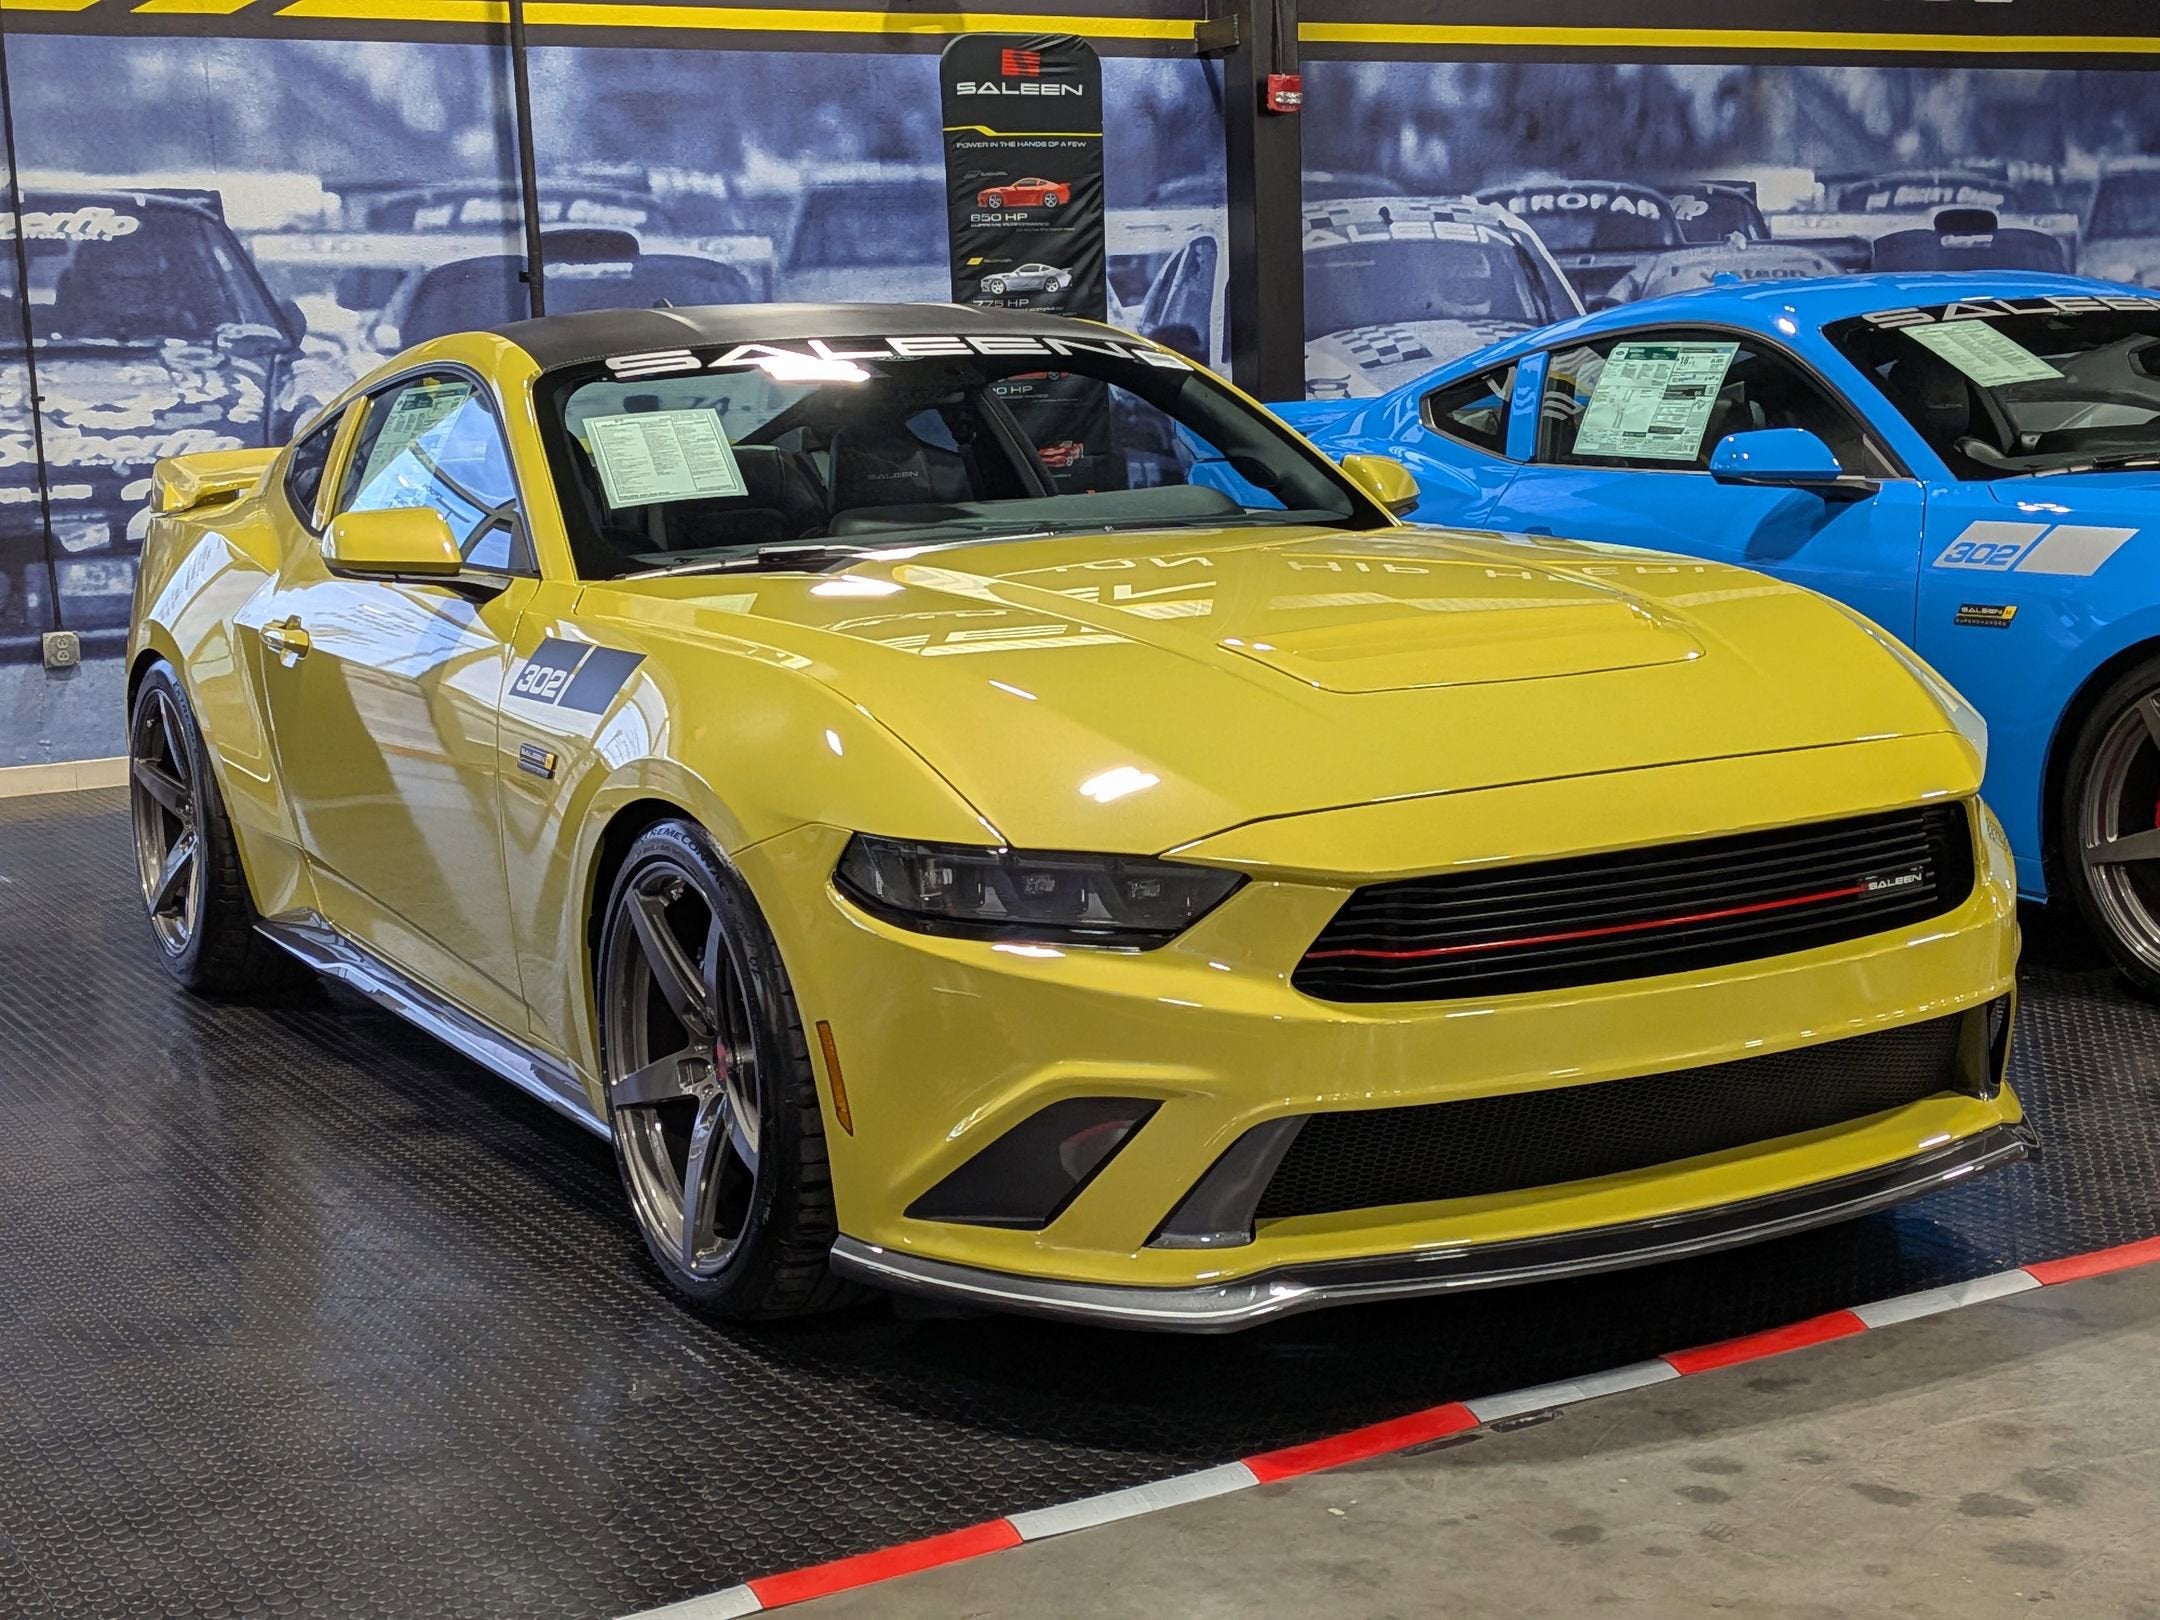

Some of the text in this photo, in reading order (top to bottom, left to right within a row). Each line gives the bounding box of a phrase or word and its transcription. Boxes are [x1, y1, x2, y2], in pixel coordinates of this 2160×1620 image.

[956, 81, 1083, 97] SALEEN
[956, 141, 989, 149] POWER
[970, 213, 1028, 222] 850 HP
[1303, 220, 1522, 252] ALEEN
[1007, 298, 1030, 307] HP
[605, 335, 1138, 379] SALEEN
[1010, 385, 1033, 394] HP
[1943, 541, 2022, 566] 302
[1961, 606, 2003, 615] SALEEN
[516, 664, 568, 699] 302
[1867, 872, 1923, 891] SALEEN
